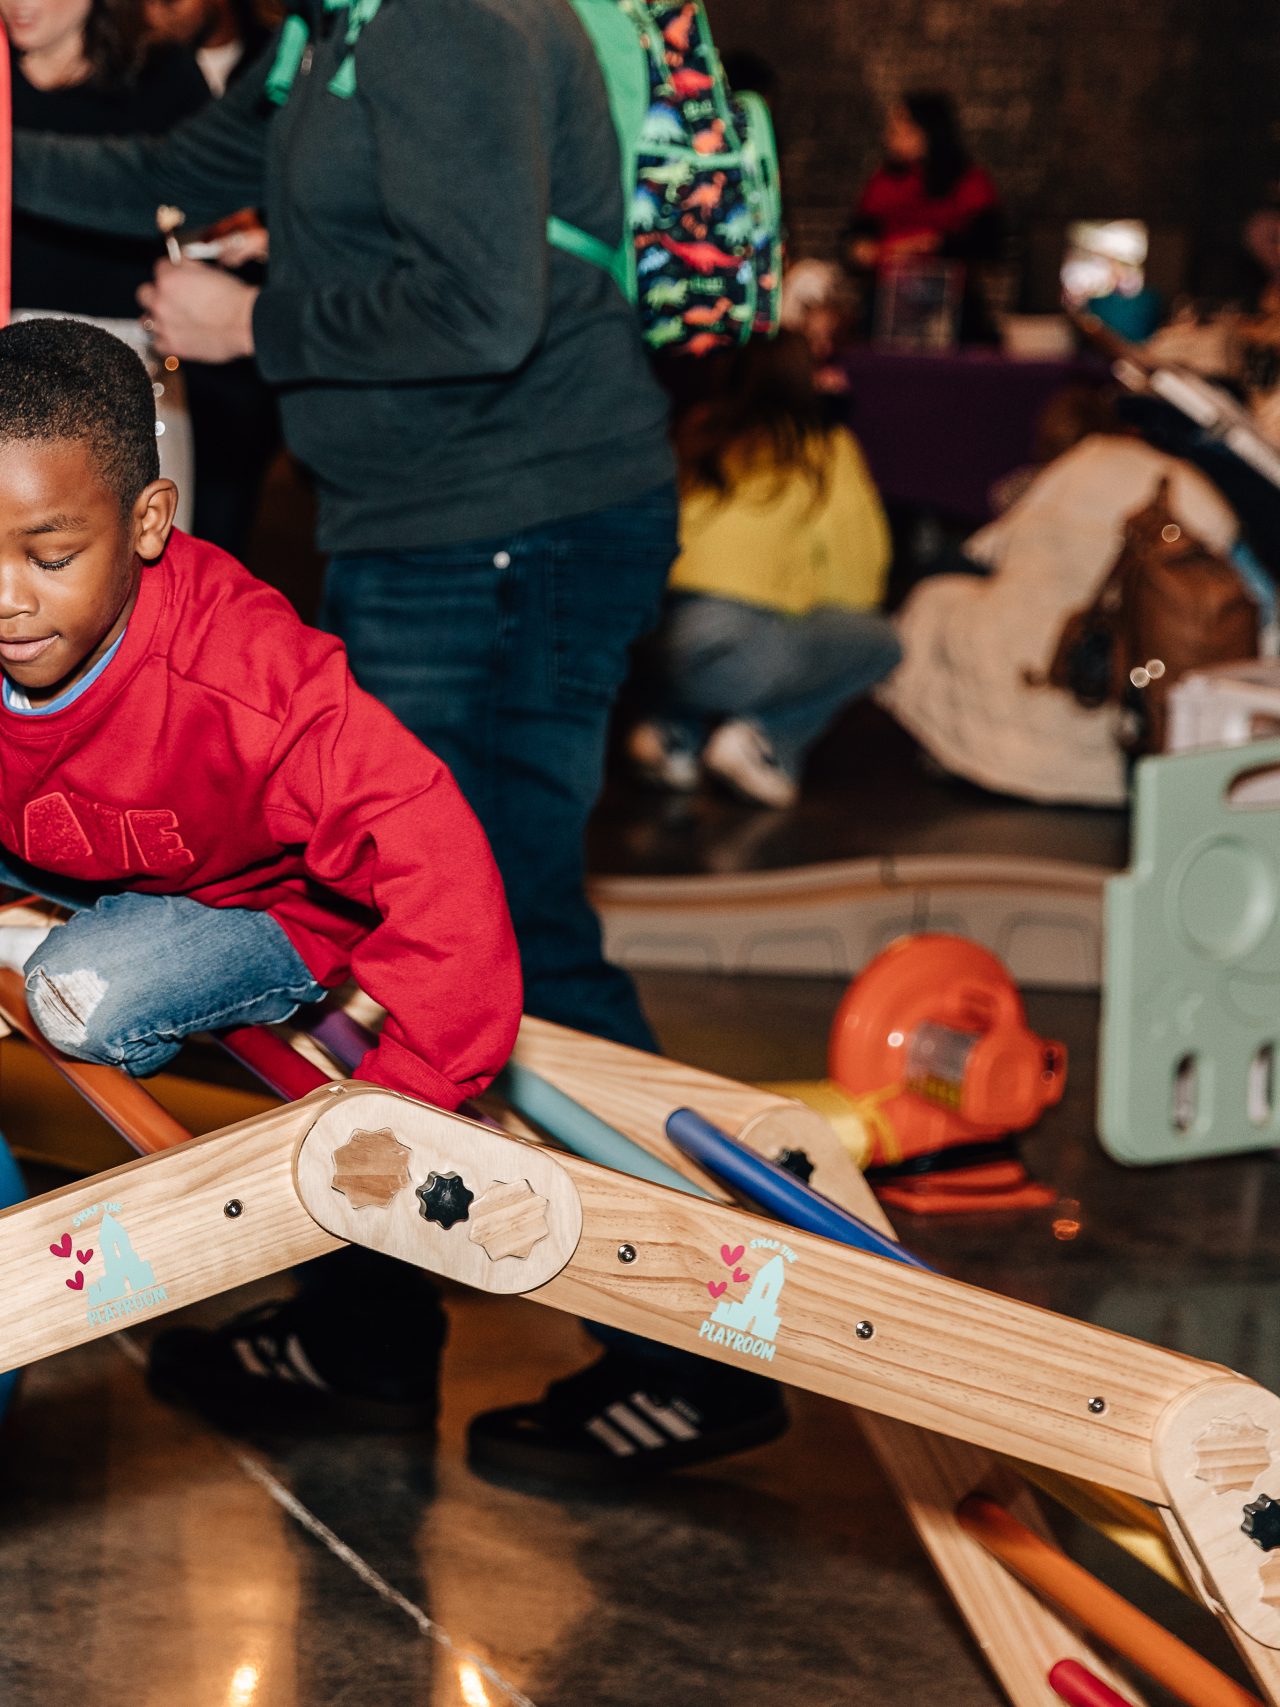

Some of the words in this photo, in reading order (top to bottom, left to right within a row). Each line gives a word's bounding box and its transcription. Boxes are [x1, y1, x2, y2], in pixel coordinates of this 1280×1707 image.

[102, 1201, 122, 1213] THE
[749, 1238, 780, 1251] SWAP
[781, 1244, 799, 1264] THE
[86, 1285, 168, 1328] PLAYROOM
[698, 1320, 776, 1362] PLAYROOM
